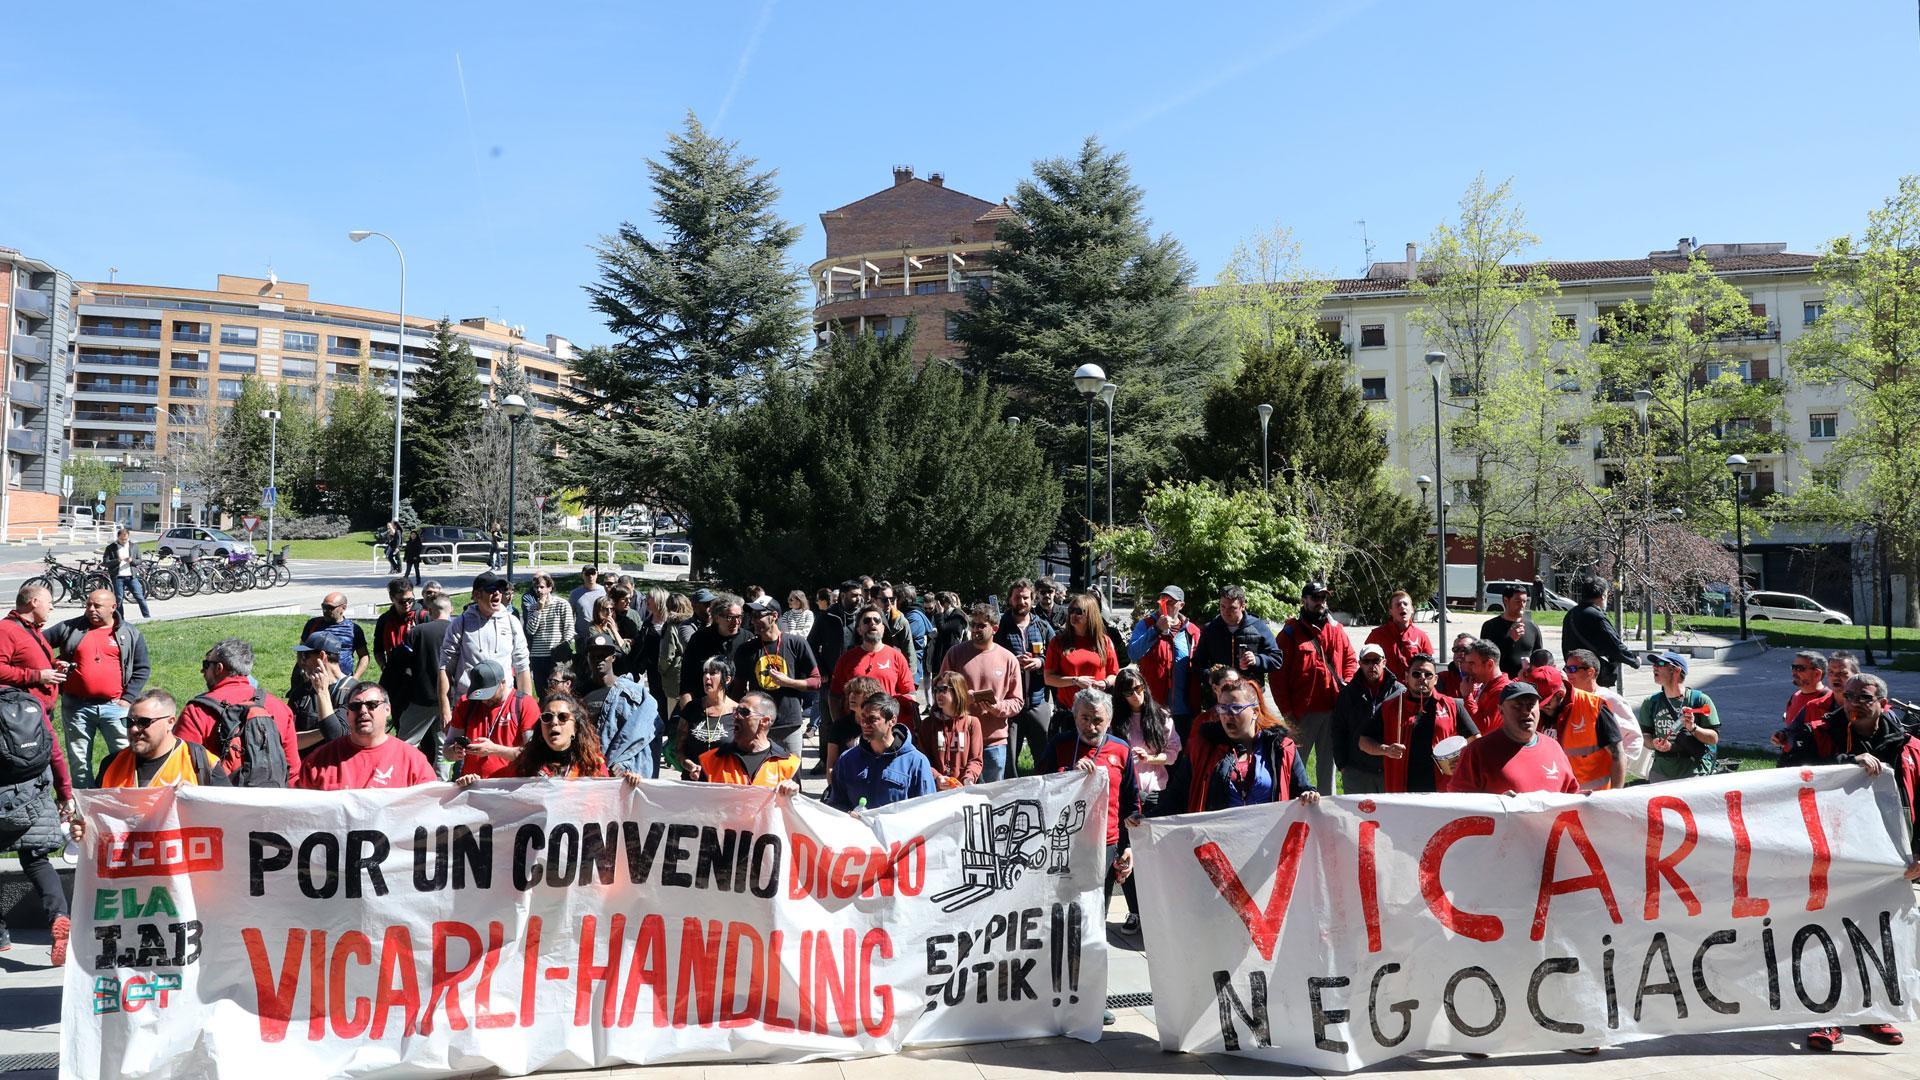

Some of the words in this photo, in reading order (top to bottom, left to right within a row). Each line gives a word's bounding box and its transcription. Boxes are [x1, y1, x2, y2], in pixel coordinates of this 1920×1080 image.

[107, 836, 212, 868] CCOO
[248, 829, 391, 899] POR
[412, 822, 494, 892] UN
[512, 820, 782, 899] CONVENIO
[787, 832, 926, 901] DIGNO
[94, 886, 180, 920] ELA
[94, 920, 203, 970] LAB
[129, 986, 153, 997] ELA
[157, 976, 180, 987] ELA
[240, 913, 895, 1043] VICARLI-HANDLING
